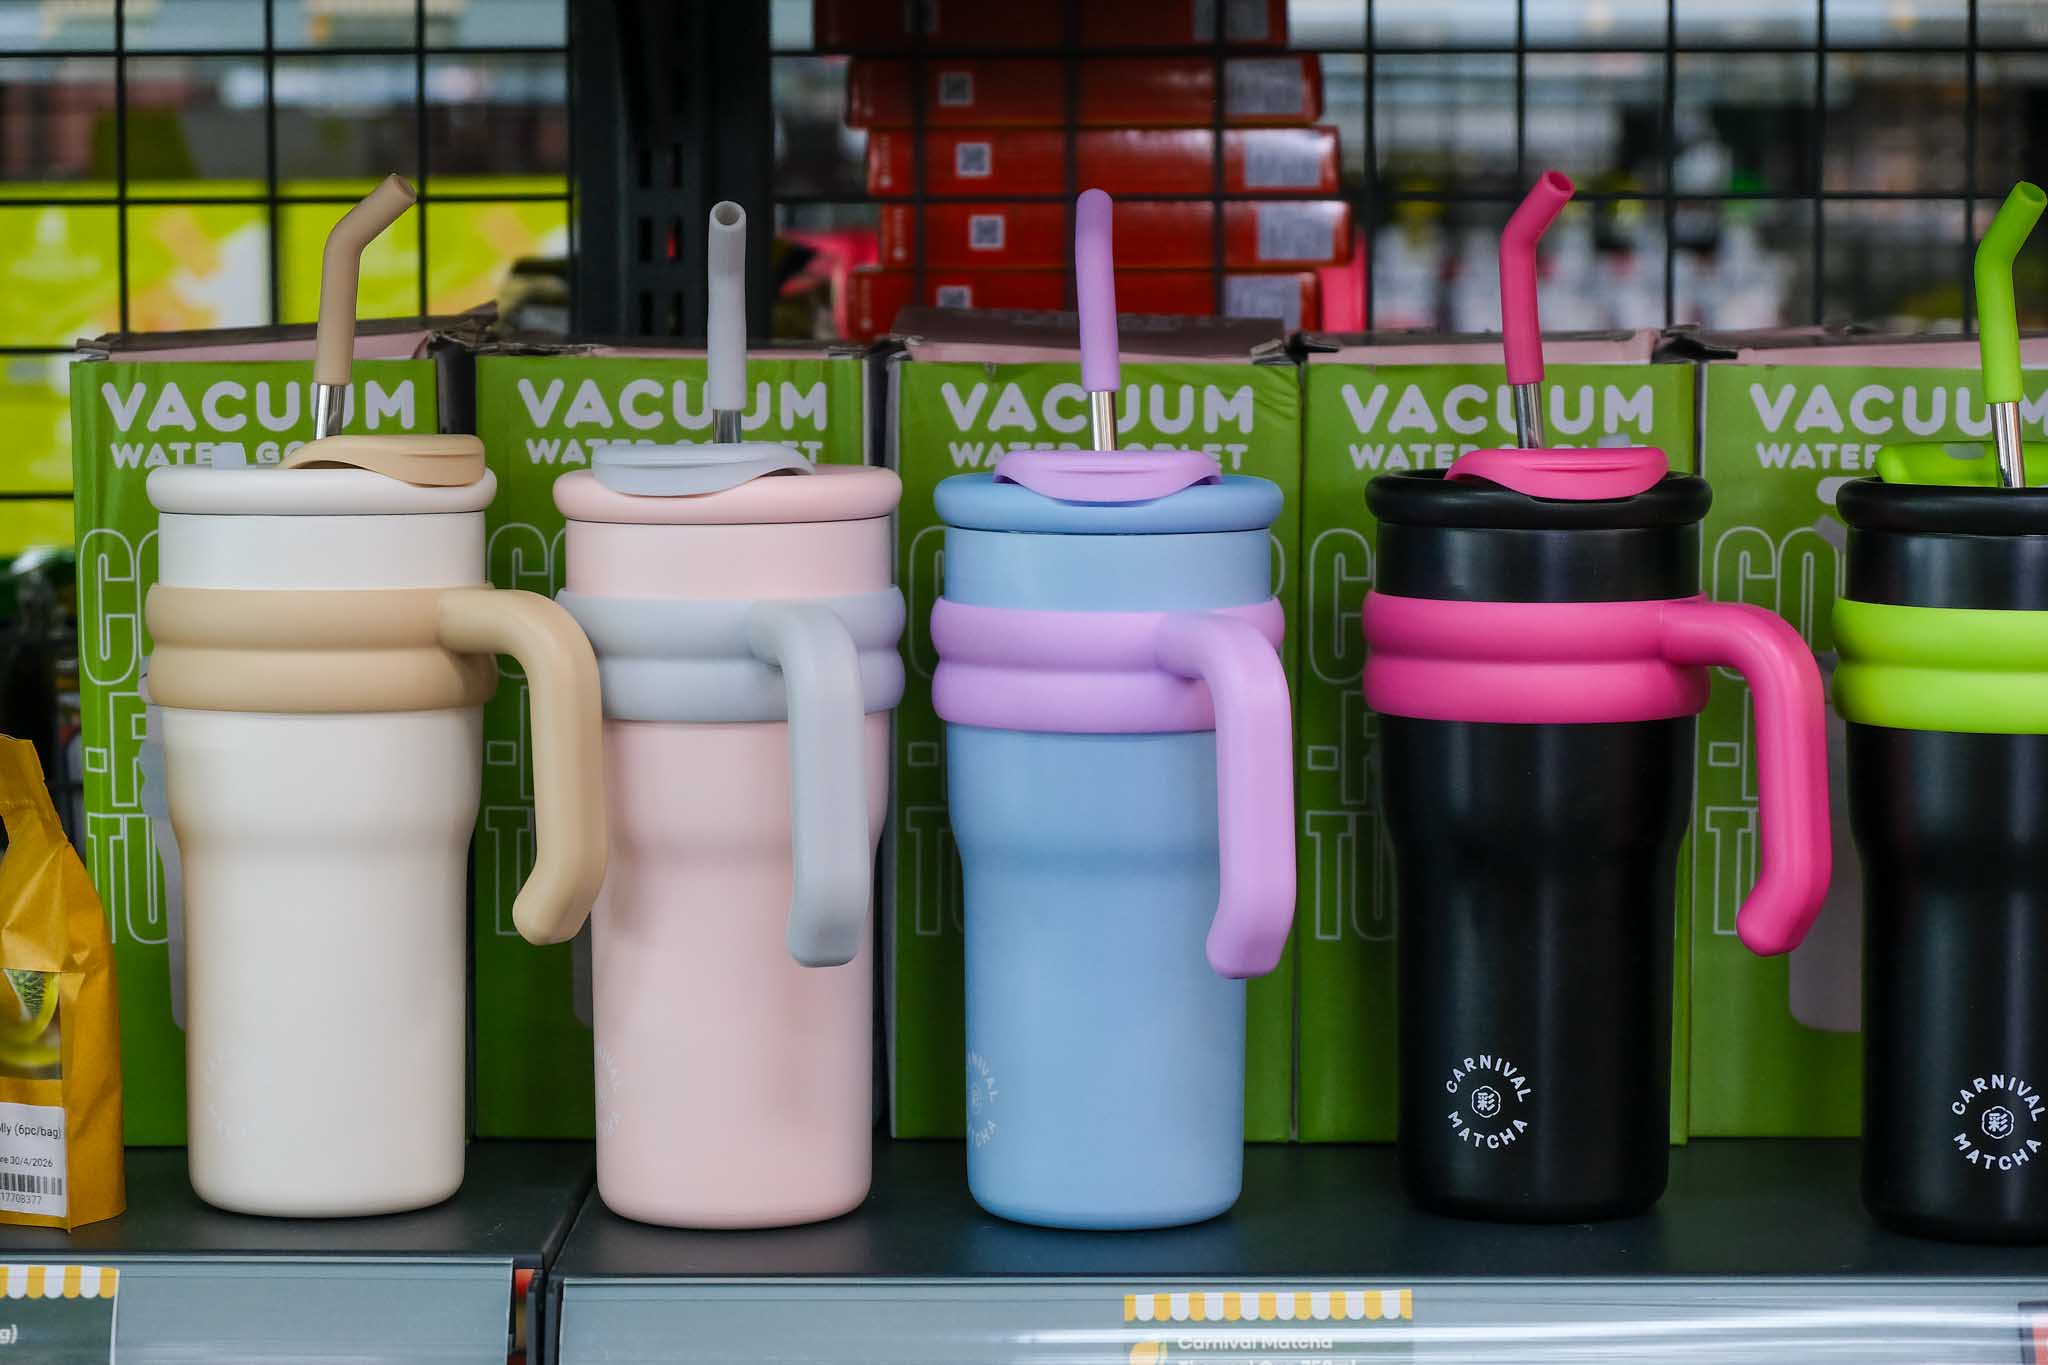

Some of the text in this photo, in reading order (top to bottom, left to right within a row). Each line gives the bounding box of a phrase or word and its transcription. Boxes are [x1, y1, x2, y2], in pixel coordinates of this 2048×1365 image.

[1446, 1054, 1531, 1103] CARNIVAL
[1951, 1074, 2046, 1122] CARNIVAL
[1447, 1111, 1528, 1149] MATCHA
[1953, 1132, 2042, 1170] MATCHA
